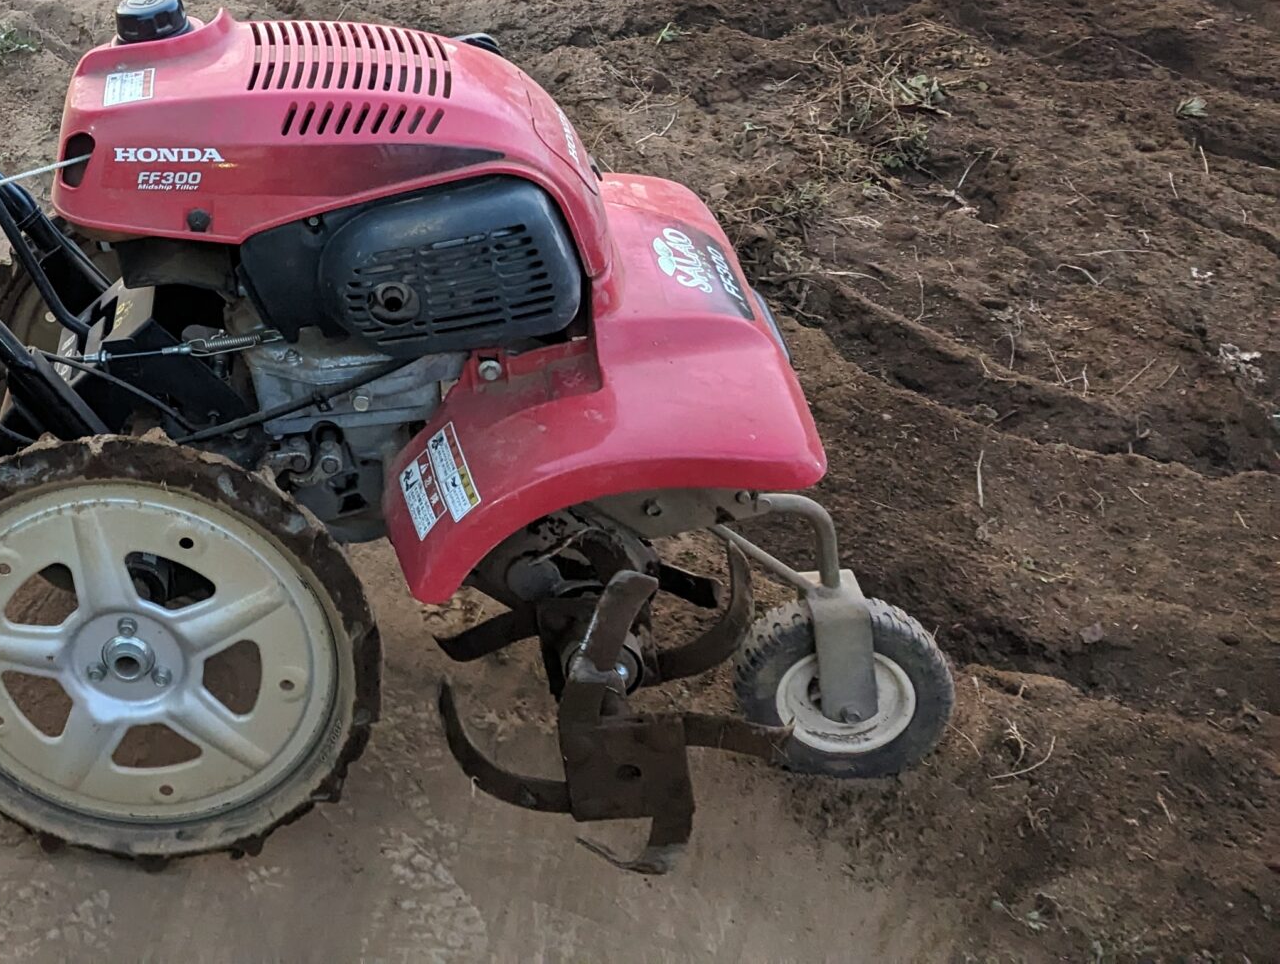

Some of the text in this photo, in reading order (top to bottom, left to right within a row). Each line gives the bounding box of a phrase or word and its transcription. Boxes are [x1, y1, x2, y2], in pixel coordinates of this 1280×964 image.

[114, 147, 225, 163] HONDA
[137, 171, 201, 185] FF300
[706, 246, 744, 301] FF300
